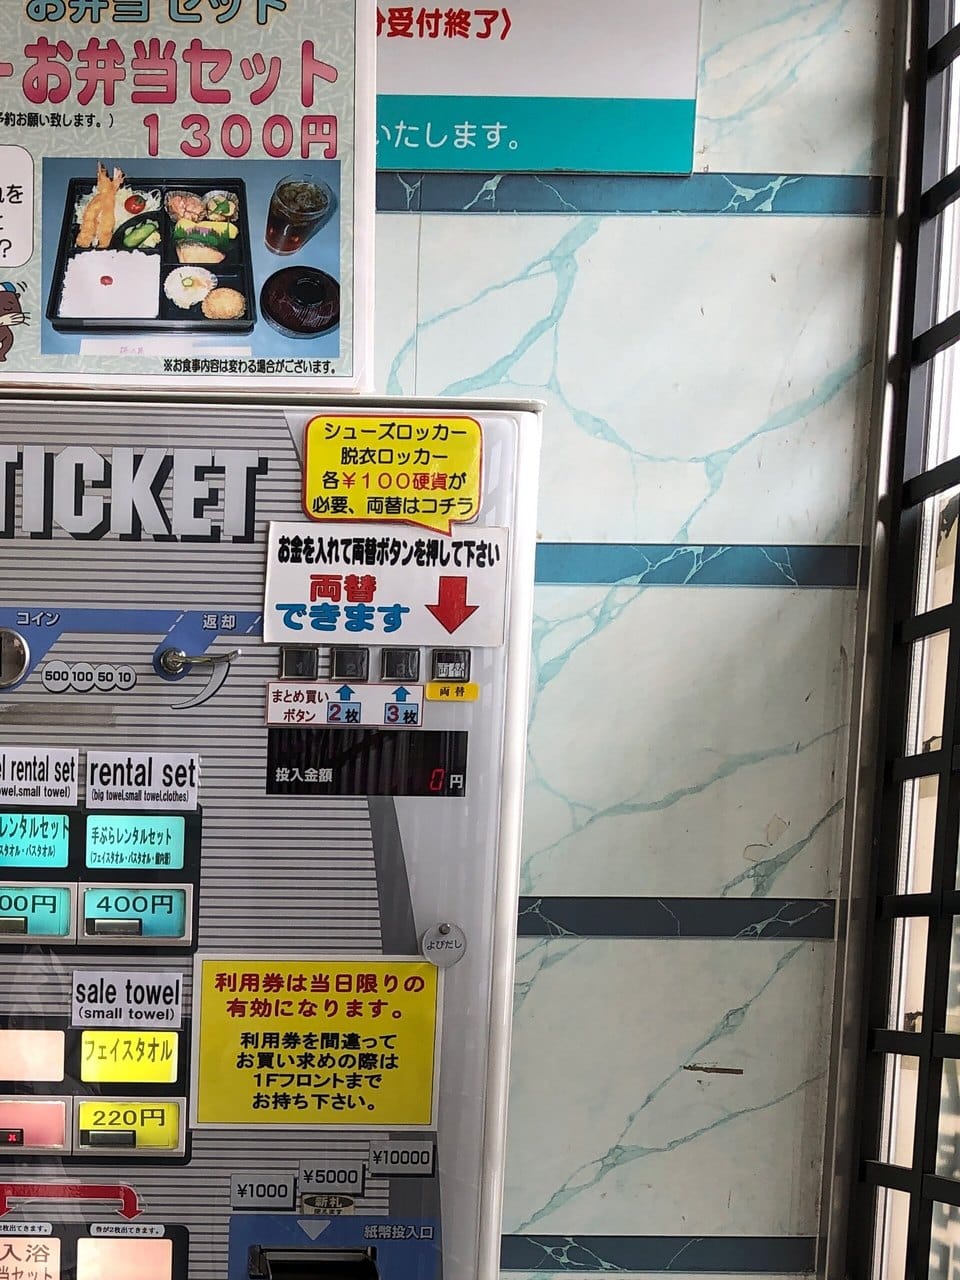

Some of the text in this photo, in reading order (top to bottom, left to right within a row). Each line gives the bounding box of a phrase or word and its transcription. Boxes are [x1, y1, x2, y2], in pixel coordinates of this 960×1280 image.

[323, 422, 469, 442] シューズロッカー
[340, 447, 449, 466] 脱衣ロッカー
[311, 495, 474, 516] 必要、両替はコチラ
[277, 534, 502, 569] お金を入れて両替ボタンを押して下さい
[309, 573, 378, 604] 両替
[15, 610, 61, 627] コイン
[201, 614, 238, 630] 返却
[275, 603, 411, 633] できます
[44, 668, 132, 684] 500 100 50 10
[271, 690, 330, 705] まとめ買い
[439, 685, 466, 698] 両替
[282, 709, 317, 723] ボタン
[329, 704, 418, 725] 2枚 3枚
[10, 755, 49, 782] rental
[54, 756, 76, 784] set
[89, 756, 197, 789] rental set
[275, 767, 334, 784] 投入金額
[43, 786, 71, 799] towel)
[91, 826, 173, 846] 手ぶらレンタルセット
[96, 895, 174, 915] 400円
[426, 938, 464, 951] よびだし
[75, 978, 180, 1006] sale towel
[214, 972, 426, 994] 利用券は当日限りの
[78, 1006, 176, 1021] (small towel)
[226, 998, 404, 1019] 有効になります。
[84, 1036, 174, 1063] フェイスタオル
[240, 1031, 398, 1050] 利用券を間違って
[236, 1051, 400, 1071] お買い求めの際は
[252, 1072, 383, 1090] 1Fフロントまで
[251, 1092, 376, 1111] お持ち下さい。
[92, 1107, 166, 1127] 220円
[372, 1149, 431, 1166] ¥10000
[302, 1168, 359, 1185] ¥5000
[236, 1182, 289, 1199] ¥1000
[363, 1224, 434, 1240] 紙幣投入口
